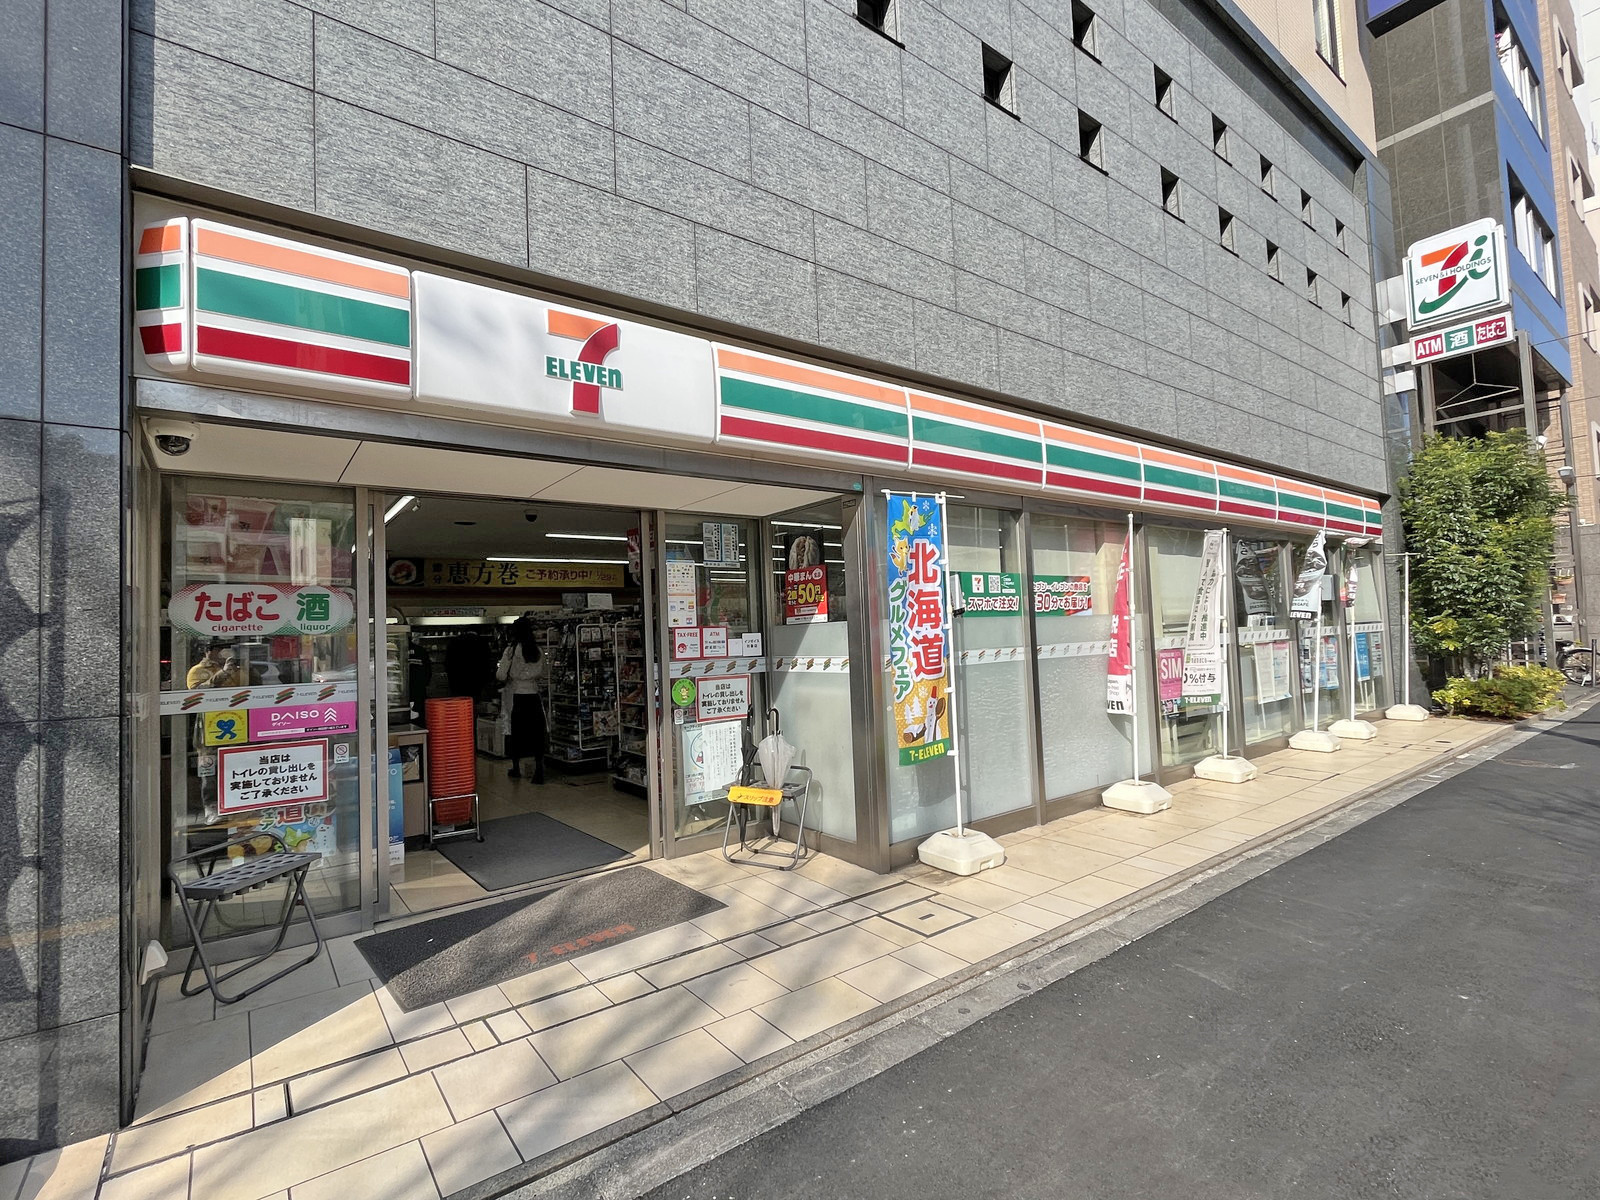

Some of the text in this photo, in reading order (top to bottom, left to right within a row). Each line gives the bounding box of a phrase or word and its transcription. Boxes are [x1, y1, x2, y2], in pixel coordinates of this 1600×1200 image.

[1449, 257, 1492, 276] HOLDINGS
[1450, 331, 1468, 349] 酒
[1476, 322, 1506, 342] たばこ
[1417, 337, 1442, 357] ATM
[448, 561, 520, 585] 恵方巻
[194, 591, 280, 622] たばこ
[296, 592, 330, 621] 酒
[907, 541, 944, 676] 北海道
[968, 597, 1019, 610] スマホで注文!
[211, 623, 264, 633] cigarette
[300, 623, 331, 632] liquor
[890, 579, 912, 700] グルメフェア
[1161, 658, 1182, 680] SIM
[271, 710, 319, 722] DAISO
[706, 706, 741, 714] ご了承ください
[259, 754, 291, 765] 当店は
[232, 763, 316, 779] トイレの貸し出しを
[230, 773, 318, 790] 実施しておりません
[240, 785, 309, 800] ご了承ください
